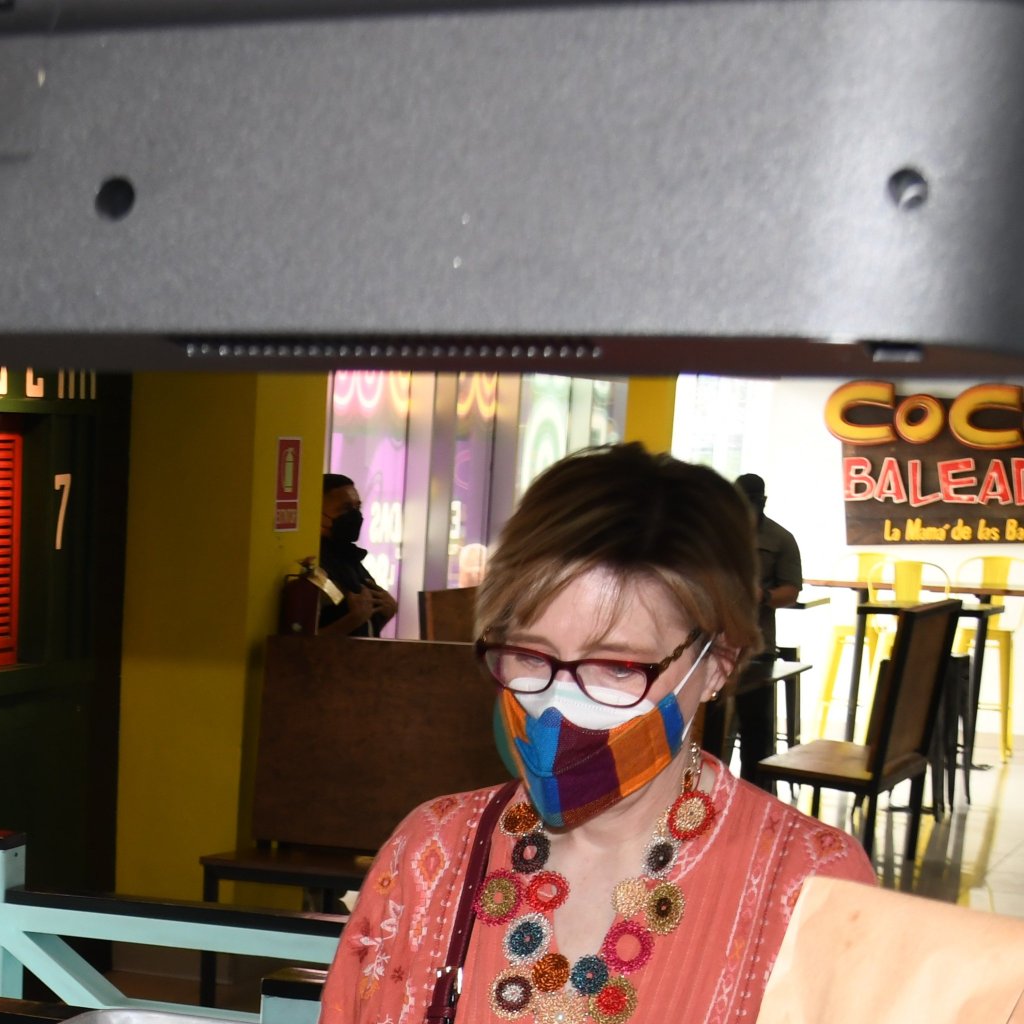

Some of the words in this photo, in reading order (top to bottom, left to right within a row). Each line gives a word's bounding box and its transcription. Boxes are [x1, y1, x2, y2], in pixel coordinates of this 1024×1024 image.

[54, 473, 72, 550] 7
[951, 518, 973, 541] de
[977, 518, 1001, 541] las
